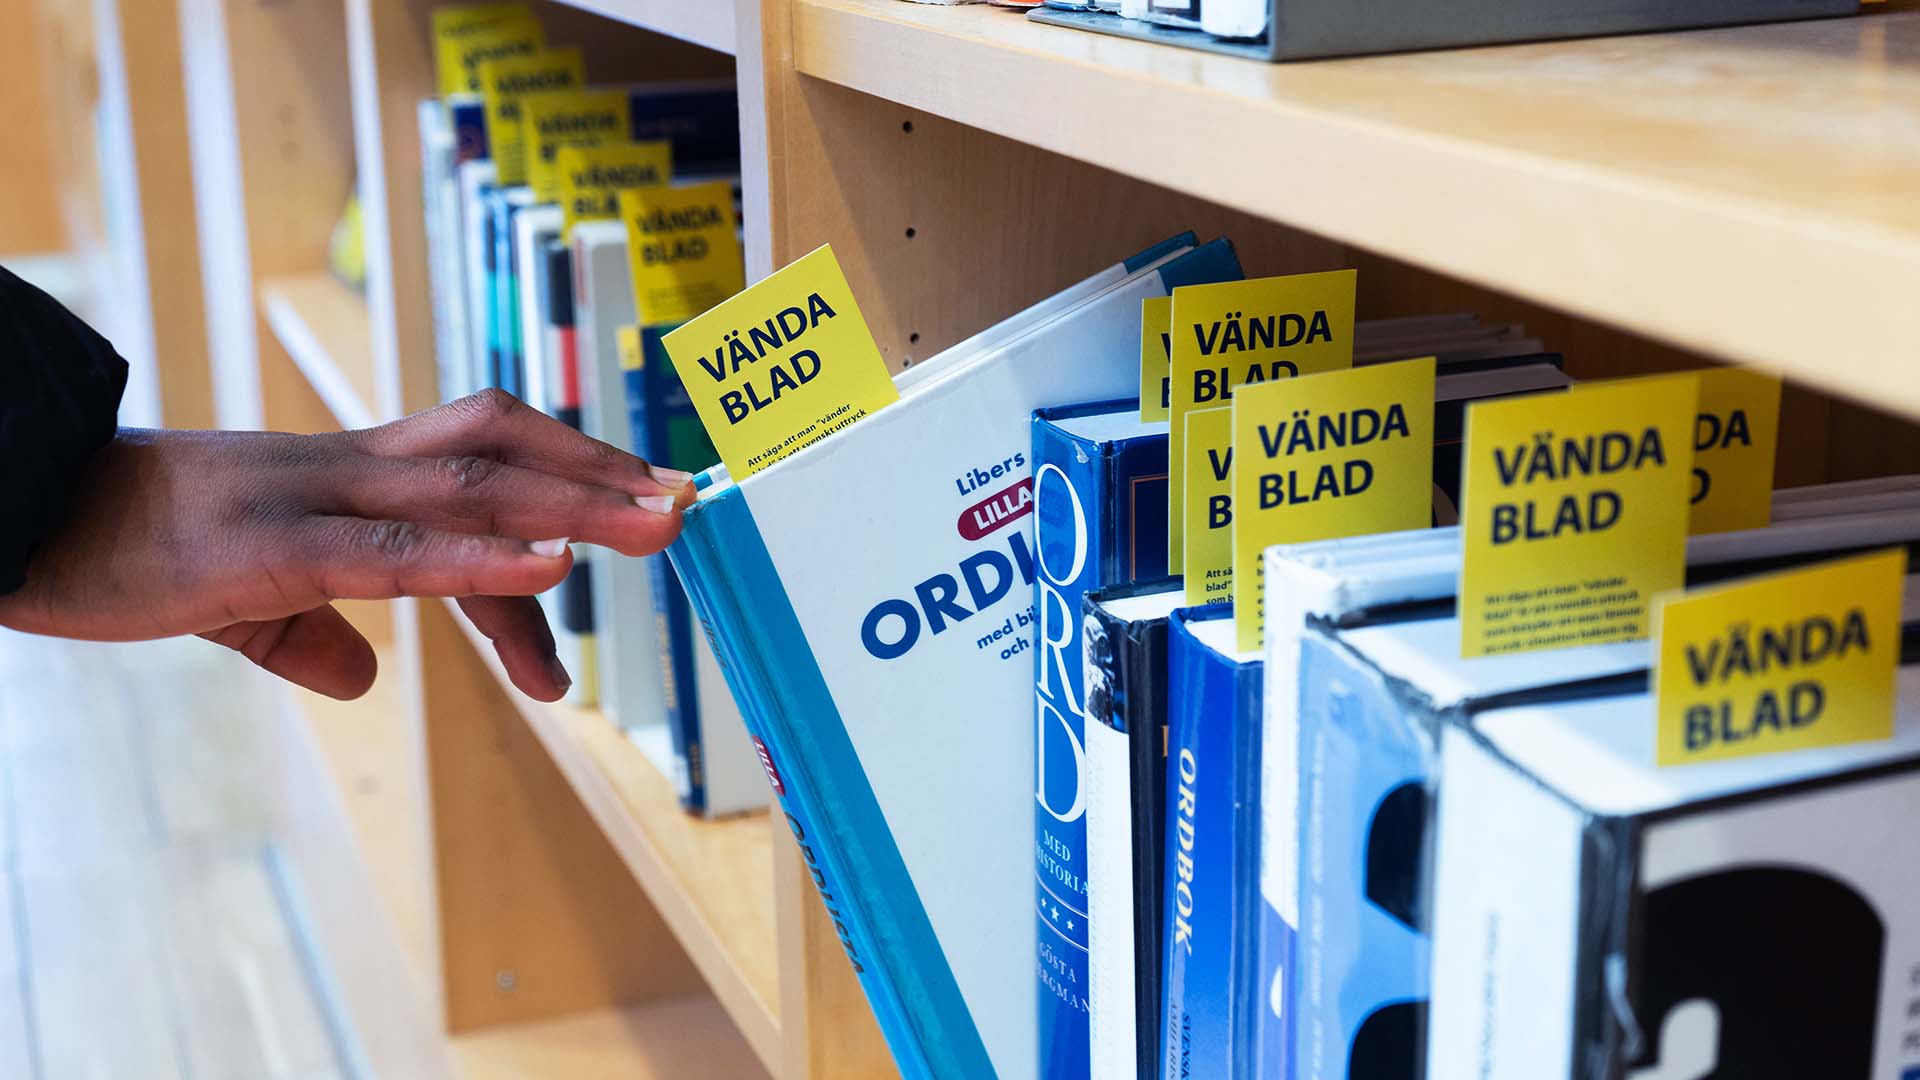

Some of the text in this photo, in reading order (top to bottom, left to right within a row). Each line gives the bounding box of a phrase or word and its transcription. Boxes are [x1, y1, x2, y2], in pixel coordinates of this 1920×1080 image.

[636, 205, 724, 235] VÄNDA
[642, 236, 710, 267] BLAD
[697, 292, 837, 383] VÄNDA
[1193, 310, 1333, 356] VÄNDA
[719, 349, 821, 425] BLAD
[834, 408, 867, 431] uttryck
[1257, 404, 1409, 459] VÄNDA
[747, 455, 762, 468] Att
[763, 444, 783, 459] säga
[783, 434, 797, 447] att
[797, 424, 816, 439] man
[1492, 426, 1666, 487] VÄNDA
[956, 452, 1026, 497] Libers
[1259, 459, 1374, 510] BLAD
[973, 485, 1034, 531] LILLA
[1490, 490, 1624, 546] BLAD
[1206, 567, 1221, 578] Att
[977, 618, 1014, 649] med
[1000, 636, 1030, 660] och
[1683, 605, 1871, 688] VÄNDA
[1682, 680, 1826, 753] BLAD
[1043, 829, 1072, 862] MED
[1174, 747, 1197, 956] ORDBOK
